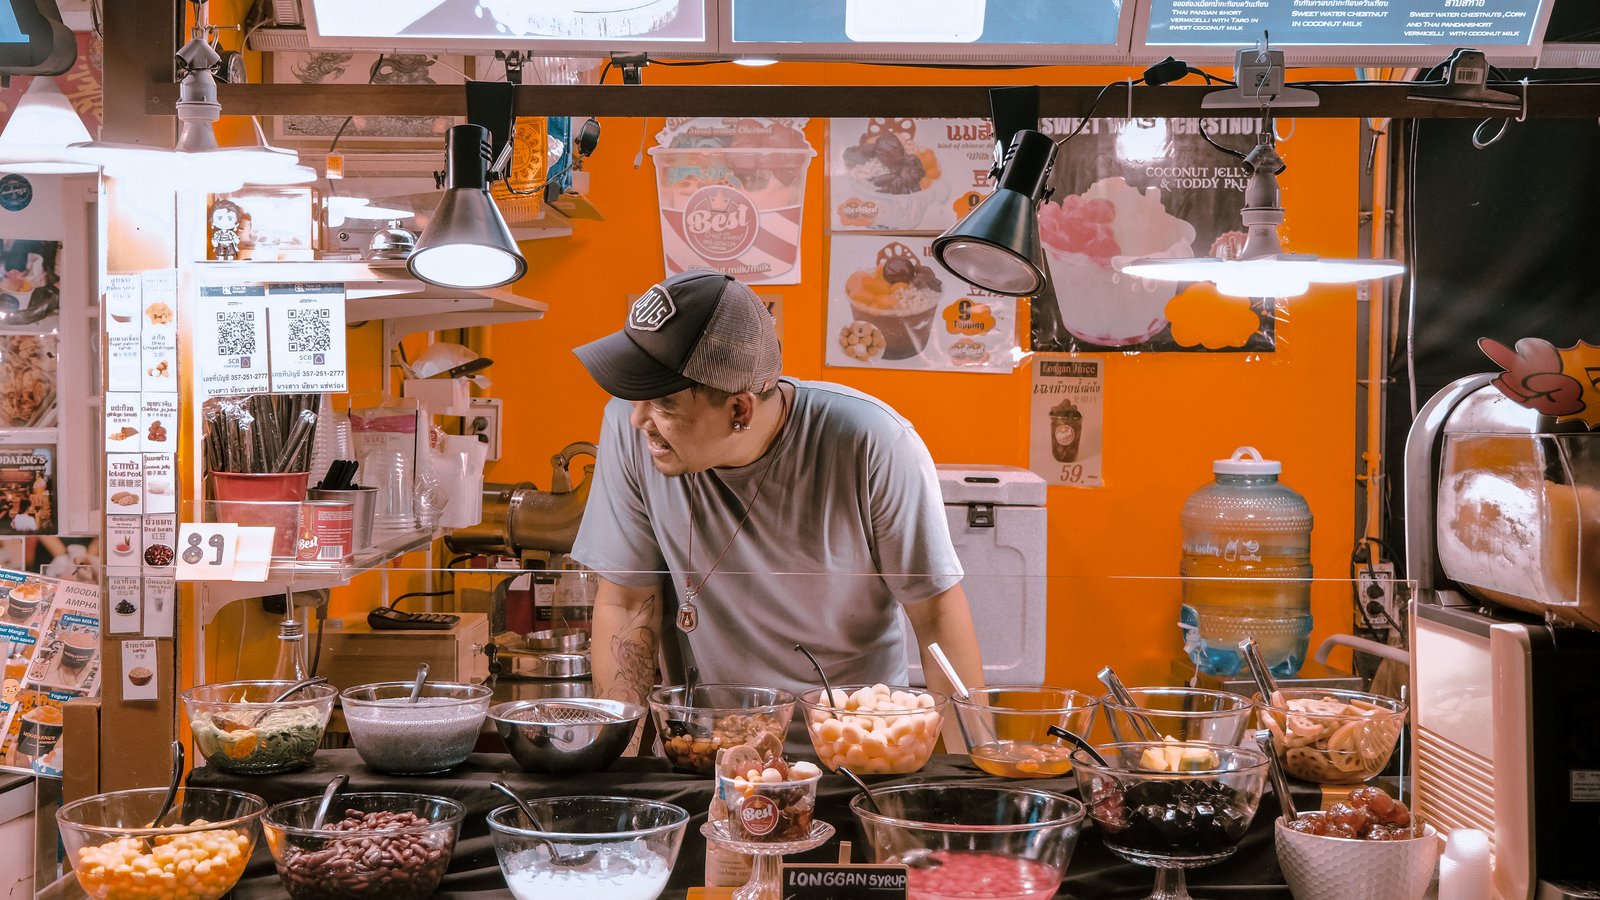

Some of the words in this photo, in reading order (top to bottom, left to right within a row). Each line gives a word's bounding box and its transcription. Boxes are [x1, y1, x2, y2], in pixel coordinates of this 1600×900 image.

[1041, 117, 1100, 134] SWEET
[1174, 117, 1263, 134] CHESTNUT
[1146, 167, 1209, 178] COCONUT
[1160, 179, 1172, 192] &
[1174, 179, 1219, 190] TODDY
[687, 203, 749, 234] Best
[635, 290, 667, 325] DEUS
[958, 301, 971, 320] 9
[954, 321, 984, 330] Topping
[231, 373, 268, 381] 357-251-2777
[1042, 364, 1071, 375] Longan
[1073, 365, 1096, 375] Juice
[182, 532, 224, 565] 89
[299, 536, 318, 550] Best
[742, 804, 773, 821] Best
[789, 871, 866, 887] LONGGAN
[869, 872, 906, 888] SYRUP
